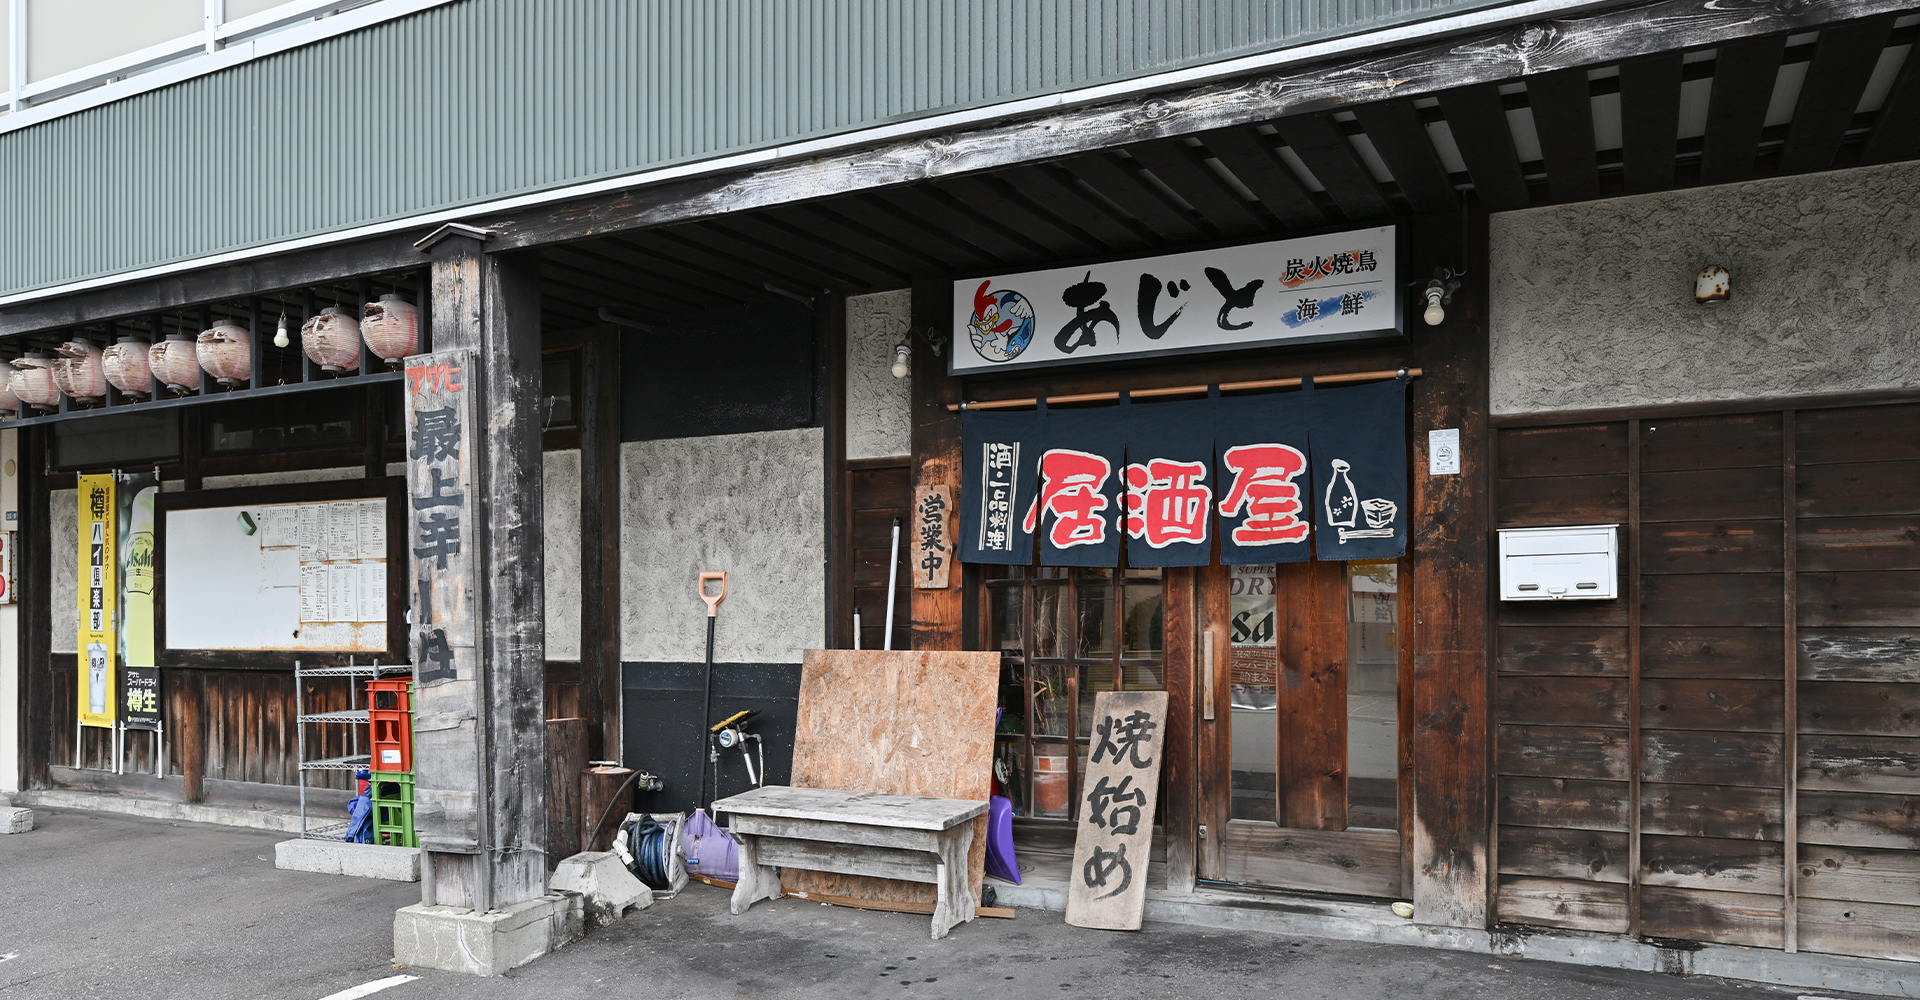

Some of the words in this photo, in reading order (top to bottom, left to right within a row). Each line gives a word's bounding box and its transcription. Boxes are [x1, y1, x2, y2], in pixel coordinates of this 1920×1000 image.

[1283, 249, 1378, 282] 炭火焼鳥
[1054, 266, 1264, 354] あじと
[1296, 292, 1365, 321] 海鮮
[406, 361, 462, 396] アサヒ
[985, 442, 1013, 550] 酒・一品料理
[1023, 443, 1311, 549] 居酒屋
[90, 487, 106, 630] 樽ハイ倶楽部
[918, 493, 946, 581] 営業中
[1237, 565, 1275, 575] SUPER
[126, 687, 158, 713] 樽生
[127, 678, 157, 687] スーパードライ
[1083, 709, 1158, 902] 焼始め
